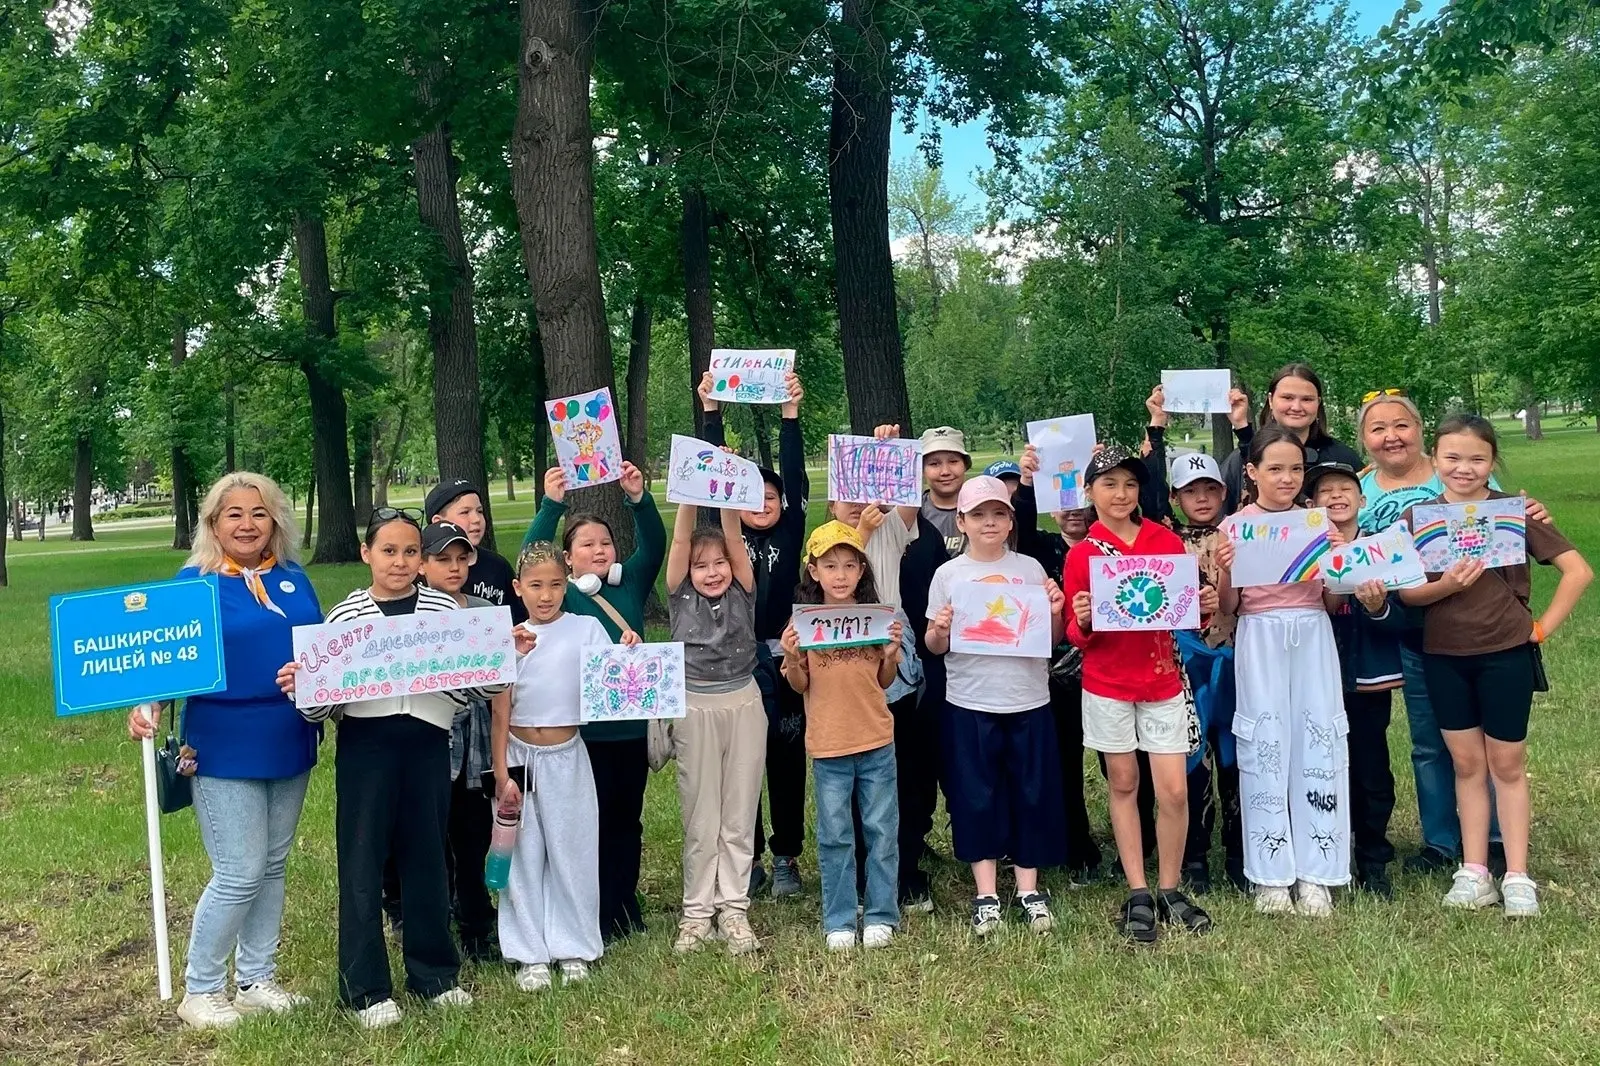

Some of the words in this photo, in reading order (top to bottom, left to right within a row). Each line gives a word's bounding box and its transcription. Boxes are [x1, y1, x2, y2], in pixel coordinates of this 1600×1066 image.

[1229, 522, 1239, 540] 1
[1102, 563, 1116, 579] 1
[1116, 557, 1175, 576] ИЮНЯ
[1164, 585, 1196, 627] 2026
[73, 619, 202, 655] БАШКИРСКИЙ
[80, 649, 145, 677] ЛИЦЕЙ
[151, 650, 172, 666] №
[177, 645, 198, 661] 48
[409, 668, 500, 692] ДЕТСТВА
